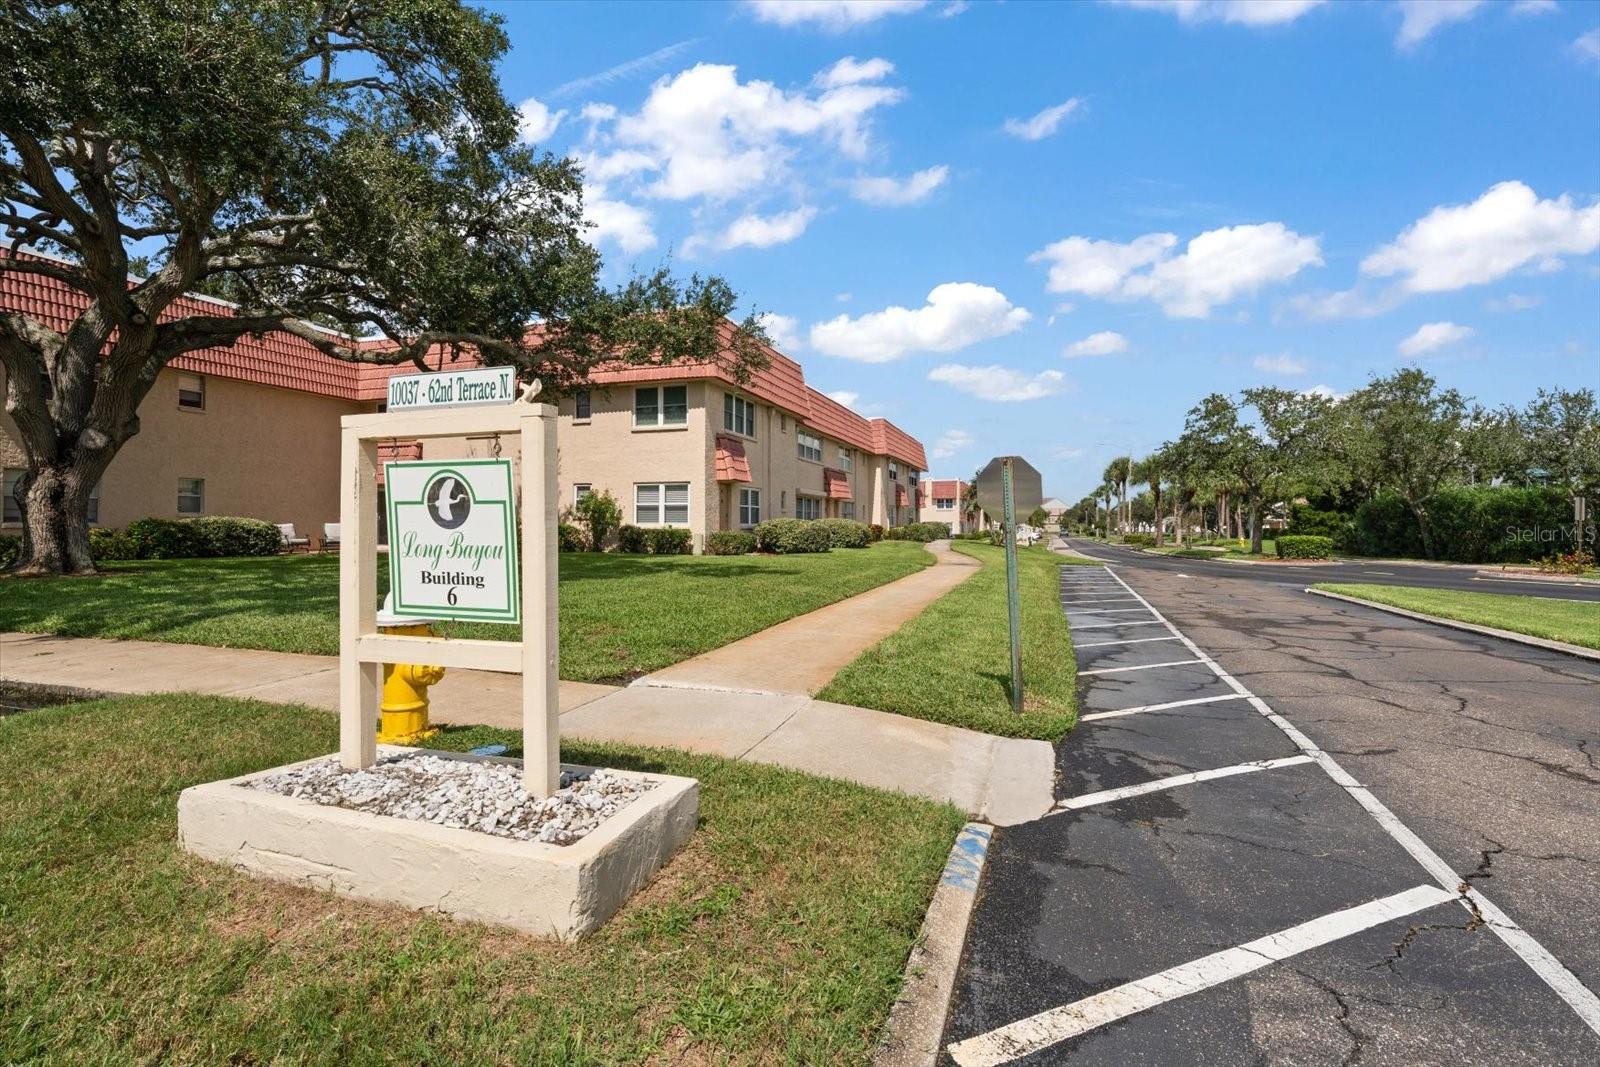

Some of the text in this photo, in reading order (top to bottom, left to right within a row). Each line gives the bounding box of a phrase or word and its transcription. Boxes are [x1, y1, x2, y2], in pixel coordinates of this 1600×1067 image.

[390, 380, 419, 406] 10037
[428, 377, 453, 402] 62nd
[456, 376, 496, 401] Terrace
[499, 373, 512, 398] N.
[402, 531, 503, 571] Long Bayou
[420, 570, 485, 588] Building
[447, 586, 458, 606] 6
